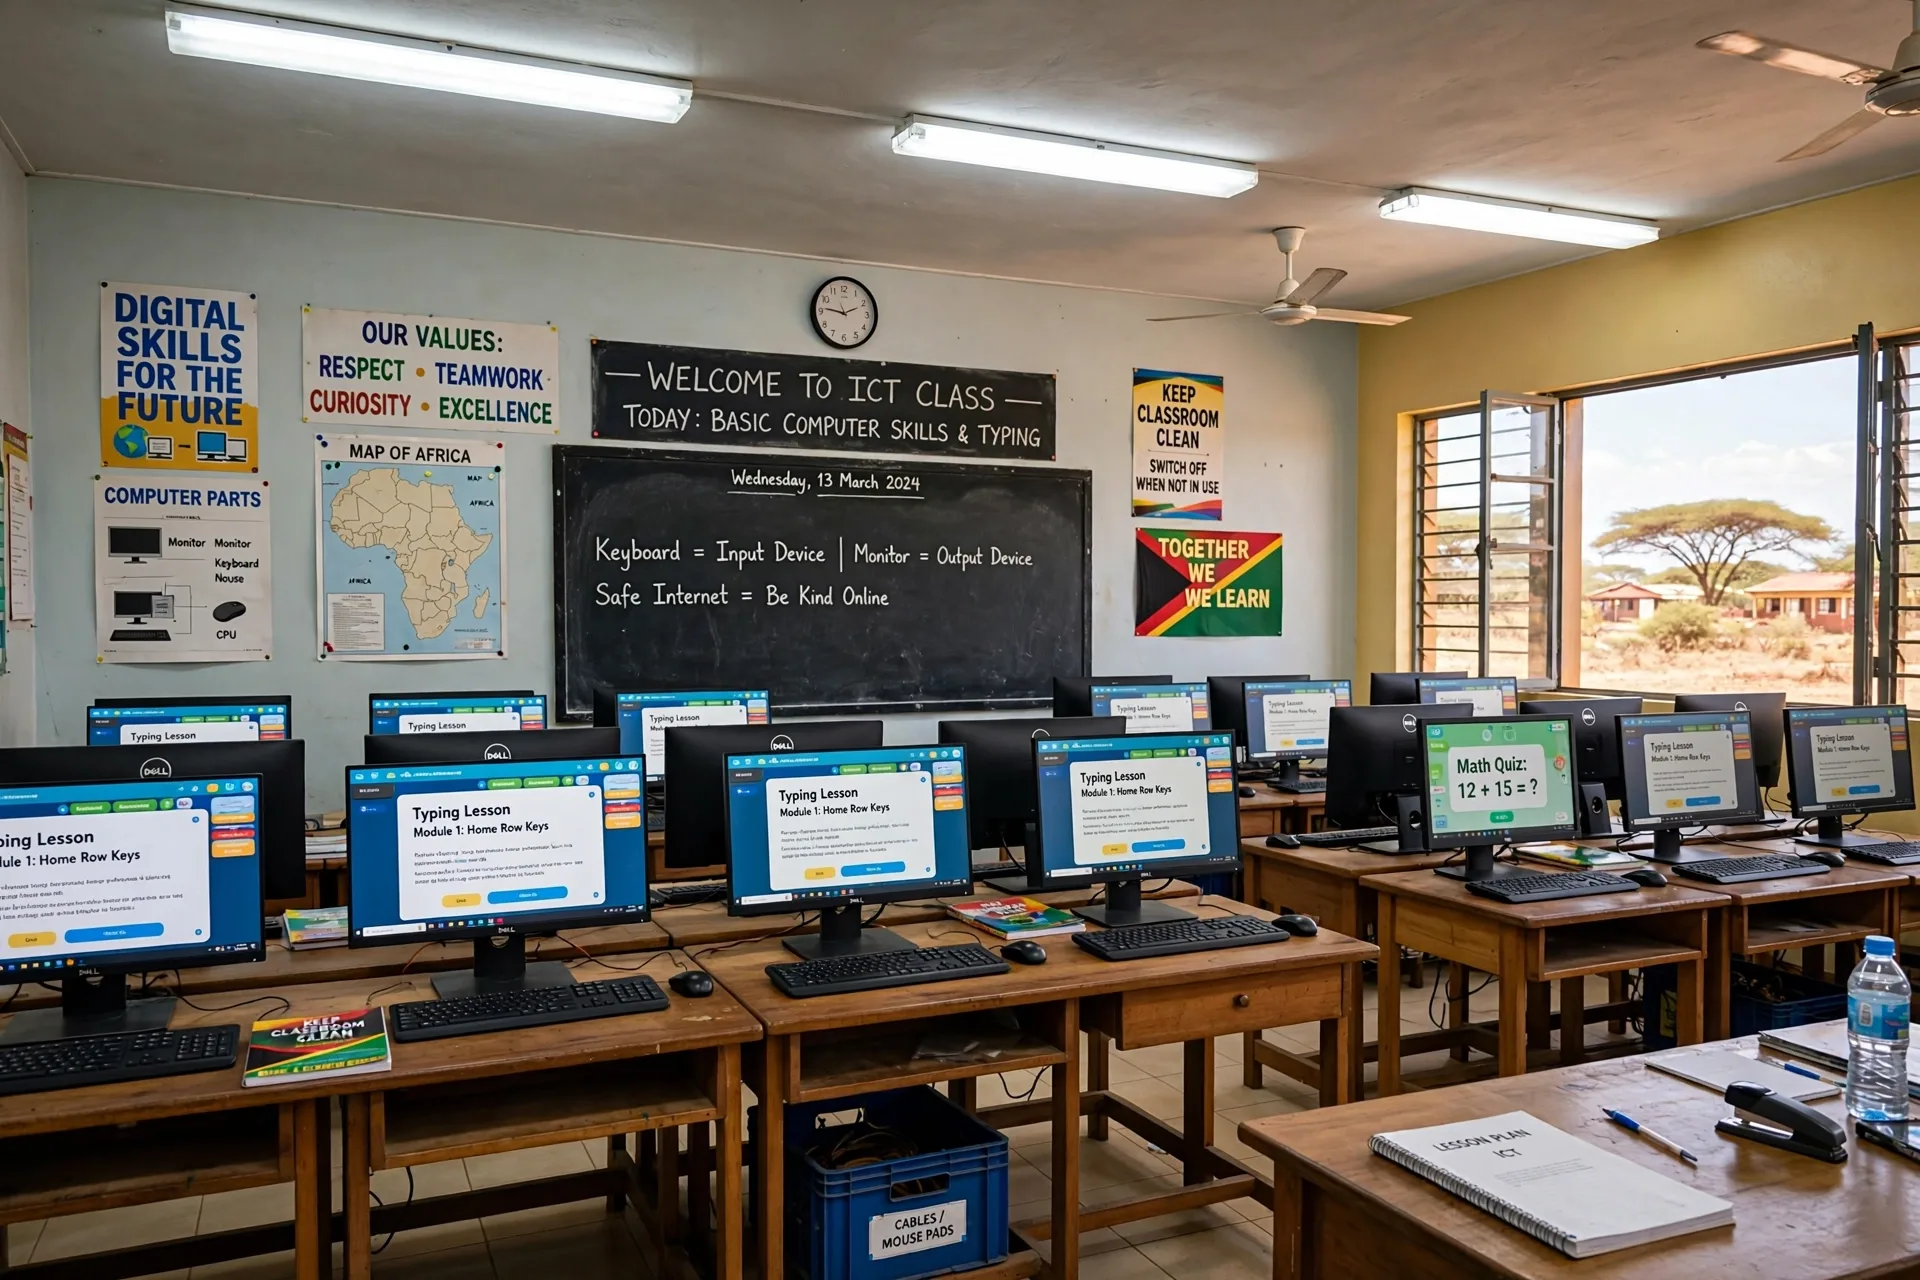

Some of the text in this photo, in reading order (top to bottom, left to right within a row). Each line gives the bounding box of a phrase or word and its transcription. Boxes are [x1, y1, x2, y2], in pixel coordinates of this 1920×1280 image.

[822, 295, 829, 303] 10
[830, 287, 836, 295] 11
[115, 292, 245, 331] DIGITAL
[117, 326, 242, 364] SKILLS
[362, 320, 503, 353] OUR VALUES:
[841, 334, 846, 342] 6
[117, 360, 242, 394] FOR THE
[319, 354, 543, 391] RESPECT TEAMWORK
[648, 361, 995, 411] WELCOME TO ICT CLASS
[1163, 383, 1196, 403] KEEP
[118, 391, 242, 426] FUTURE
[310, 389, 552, 424] CURIOSITY EXCELLENCE
[1138, 404, 1219, 428] CLASSROOM
[623, 404, 1041, 447] TODAY: BASIC COMPUTER SKILLS & TYPING
[1157, 428, 1199, 449] CLEAN
[349, 444, 471, 463] MAP OF AFRICA
[1150, 459, 1207, 476] SWITCH OFF
[731, 469, 921, 494] Wednesday, 13 March 2024
[1136, 477, 1219, 494] WHEN NOT IN USE
[104, 487, 261, 508] COMPUTER PARTS
[168, 537, 251, 549] Monitor Monitor
[1158, 538, 1249, 559] TOGETHER
[596, 536, 680, 571] Keyboard
[716, 540, 764, 570] Input
[775, 540, 825, 562] Device
[854, 543, 910, 564] Monitor
[937, 545, 983, 572] Output
[991, 546, 1033, 566] Device
[215, 558, 259, 570] Keyboard
[1188, 563, 1215, 582] WE
[595, 582, 641, 609] Safe
[653, 583, 728, 605] Internet
[766, 585, 789, 605] Be
[799, 584, 833, 605] Kind
[843, 586, 889, 606] Online
[1185, 588, 1270, 608] WE LEARN
[216, 630, 237, 640] CPU
[408, 722, 436, 732] Typing
[650, 714, 674, 723] Typing
[131, 732, 196, 742] Typing Lesson
[1817, 734, 1835, 744] Typing
[1651, 742, 1671, 752] Typing
[144, 768, 168, 776] DELL
[1457, 756, 1527, 773] Math Quiz:
[1080, 771, 1146, 786] Typing Lesson
[1458, 778, 1538, 798] 12 + 15 = ?
[779, 788, 858, 804] Typing Lesson
[1081, 785, 1171, 797] Module 1: Home Row Keys
[413, 804, 511, 823] Typing Lesson
[780, 802, 890, 817] Module 1: Home Row Keys
[38, 832, 94, 846] Lesson
[414, 821, 549, 838] Module 1: Home Row Keys
[0, 850, 140, 868] ule 1: Home Row Keys
[1433, 1129, 1532, 1152] LESSON PLAN
[1493, 1148, 1522, 1158] ICT
[895, 1210, 944, 1230] CABLES /
[882, 1225, 954, 1249] MOUSE PADS
